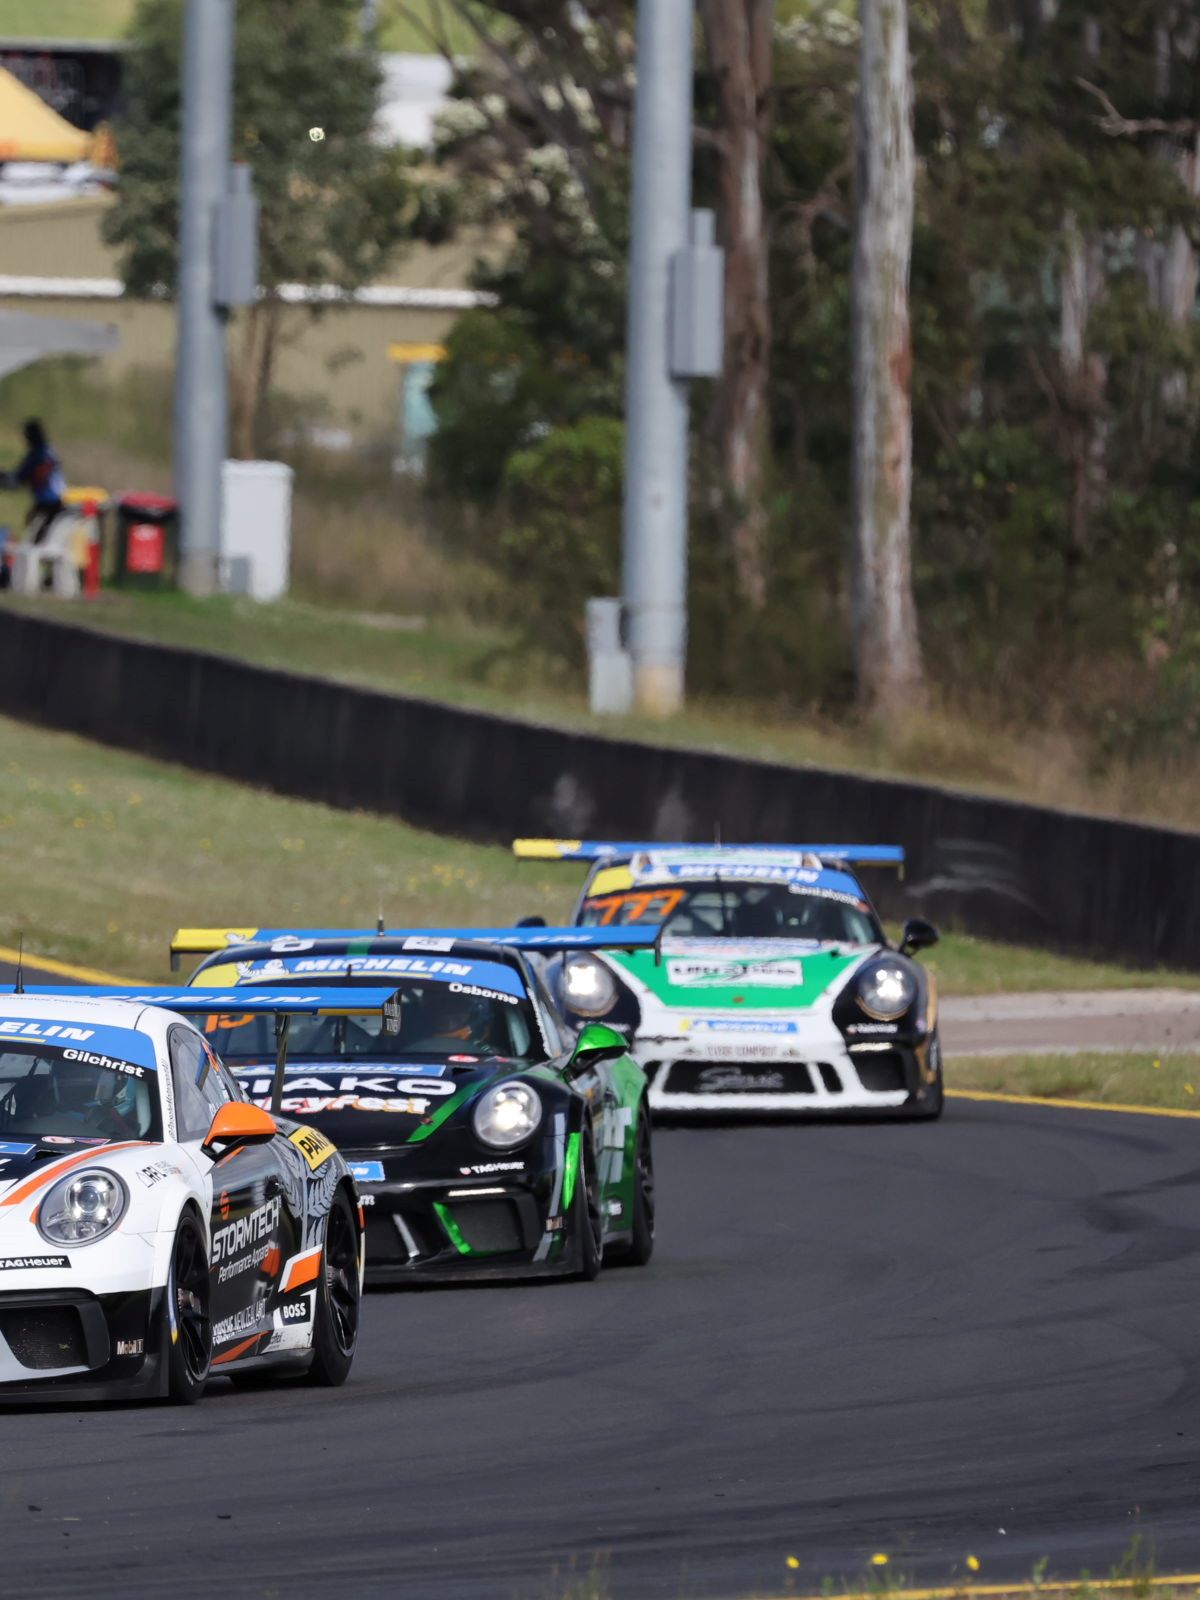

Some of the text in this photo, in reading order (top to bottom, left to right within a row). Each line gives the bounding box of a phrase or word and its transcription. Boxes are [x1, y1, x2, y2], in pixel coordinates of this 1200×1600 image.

[678, 864, 820, 883] MICHELIN
[584, 889, 686, 925] 777
[294, 957, 474, 977] MICHELIN
[448, 982, 520, 1006] Osborne
[62, 1048, 146, 1079] Gilchrist
[211, 1195, 280, 1265] STORMTECH
[282, 1302, 307, 1319] BOSS
[117, 1340, 136, 1355] Mobil
